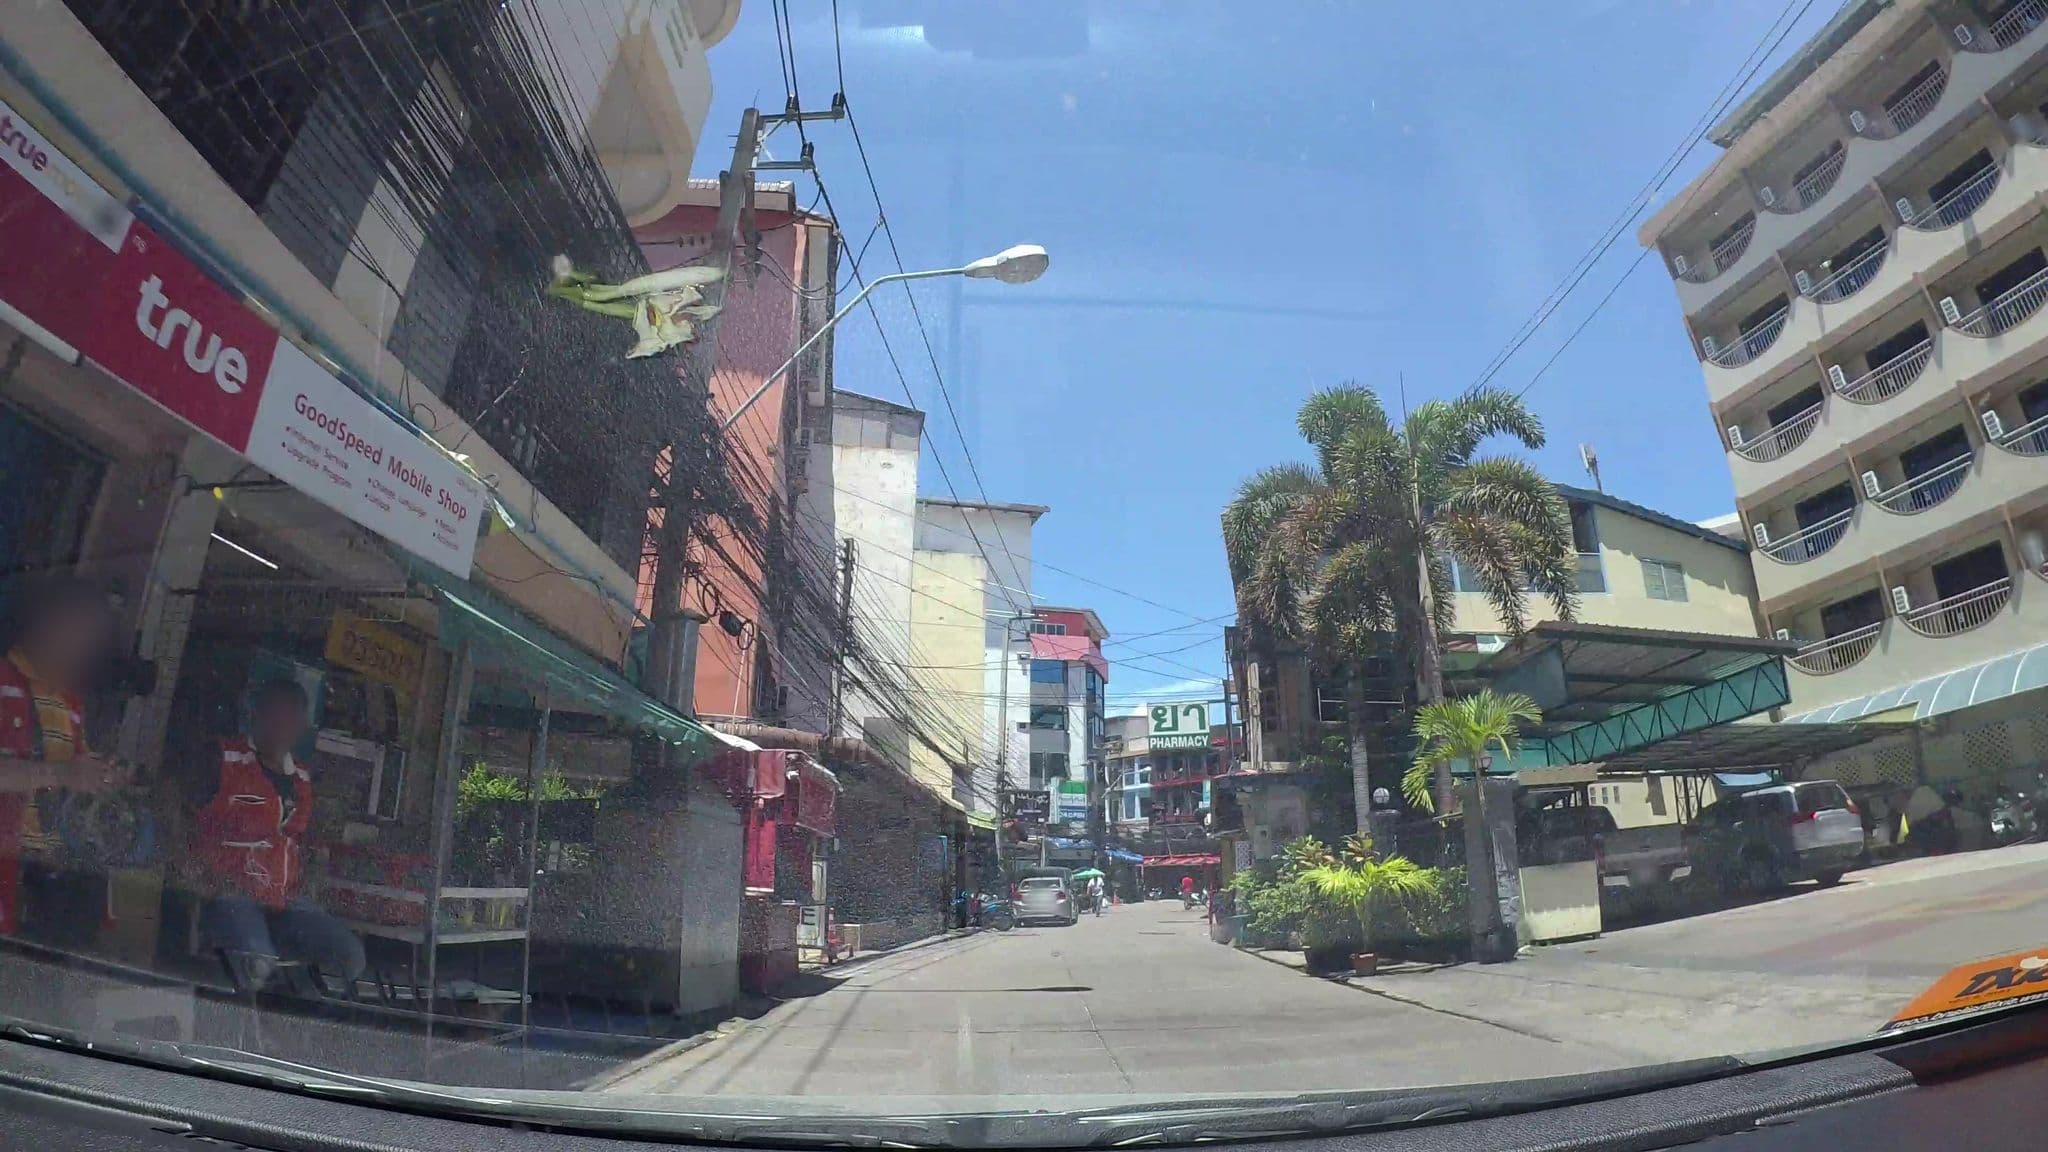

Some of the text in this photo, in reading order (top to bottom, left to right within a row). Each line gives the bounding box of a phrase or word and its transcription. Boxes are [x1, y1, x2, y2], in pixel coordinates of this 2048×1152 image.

[136, 274, 248, 394] true
[294, 393, 383, 465] GoodSpeed
[387, 456, 433, 498] Mobile
[437, 488, 467, 520] Shop
[1149, 735, 1209, 750] PHARMACY
[1151, 704, 1206, 732] ยา
